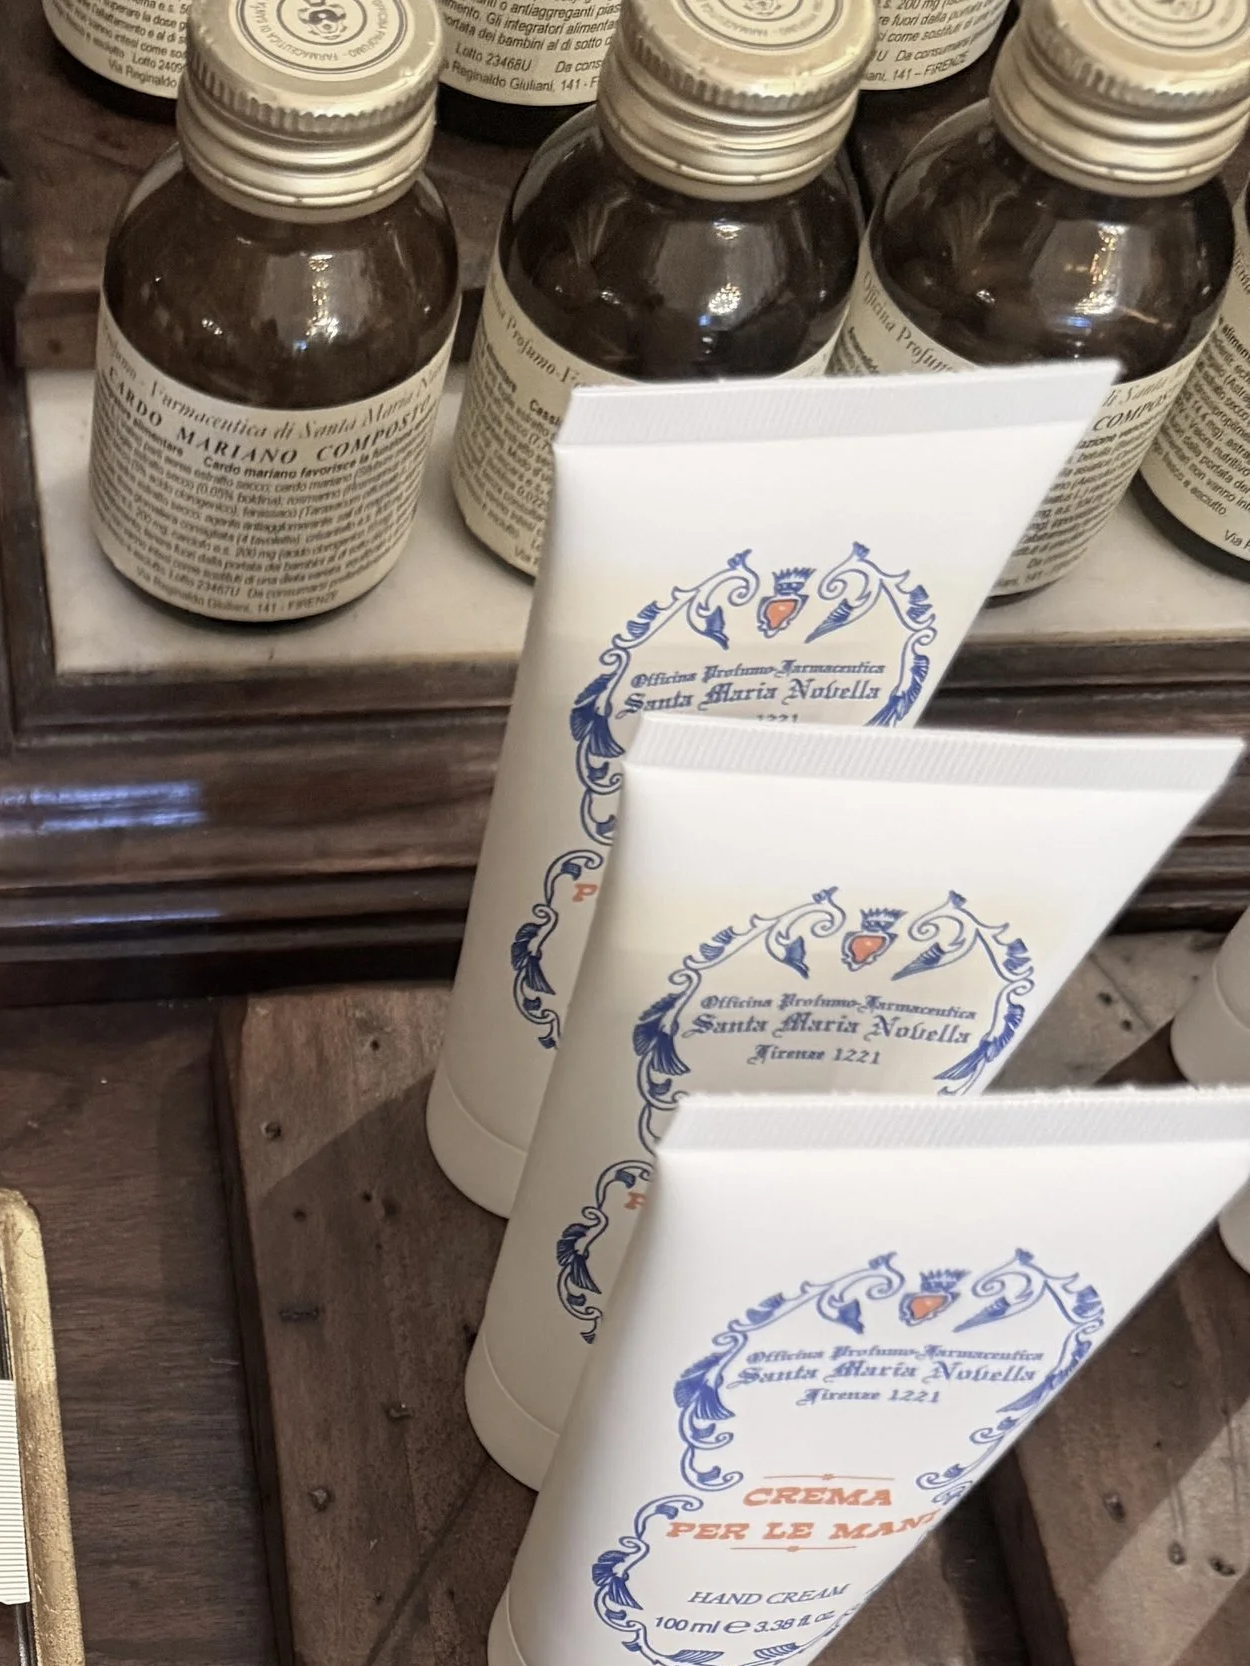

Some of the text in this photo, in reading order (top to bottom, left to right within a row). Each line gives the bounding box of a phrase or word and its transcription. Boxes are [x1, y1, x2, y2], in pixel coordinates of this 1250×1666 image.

[486, 11, 562, 35] Gli integratori
[510, 3, 594, 21] antiaggreganti
[498, 34, 543, 50] bambini
[888, 30, 919, 42] come
[455, 42, 482, 62] Lotto
[485, 52, 531, 72] 23468U
[125, 64, 177, 88] Reginaldo
[452, 62, 580, 92] Reginaldo Giuliani, 141
[893, 68, 911, 80] 141
[108, 364, 431, 465] CARDO MARIANO COMPOSTO
[150, 379, 267, 438] Farmaceutica
[273, 421, 294, 441] di
[300, 418, 356, 440] Santa
[204, 455, 241, 476] Cardo
[244, 467, 297, 480] mariano
[300, 457, 356, 479] favorisce
[1225, 530, 1242, 547] Via
[631, 659, 886, 689] Officina Profumo-Farmaceutica
[615, 676, 883, 719] Santa Maria Novella
[700, 993, 978, 1021] Officina Profumo-Farmaceutica
[682, 1010, 972, 1044] Santa Maria Novella
[746, 1043, 881, 1065] Firenze 1221
[745, 1344, 1045, 1365] Officina Profumo-Farmaceutica
[728, 1359, 1039, 1389] Santa Maria Novella
[795, 1387, 941, 1407] Firenze 1221
[742, 1486, 893, 1507] CREMA
[665, 1521, 750, 1541] PER
[761, 1521, 815, 1540] LE
[687, 1583, 852, 1605] HAND CREAM
[654, 1615, 689, 1632] 100
[689, 1619, 720, 1634] ml
[753, 1617, 795, 1634] 3.38
